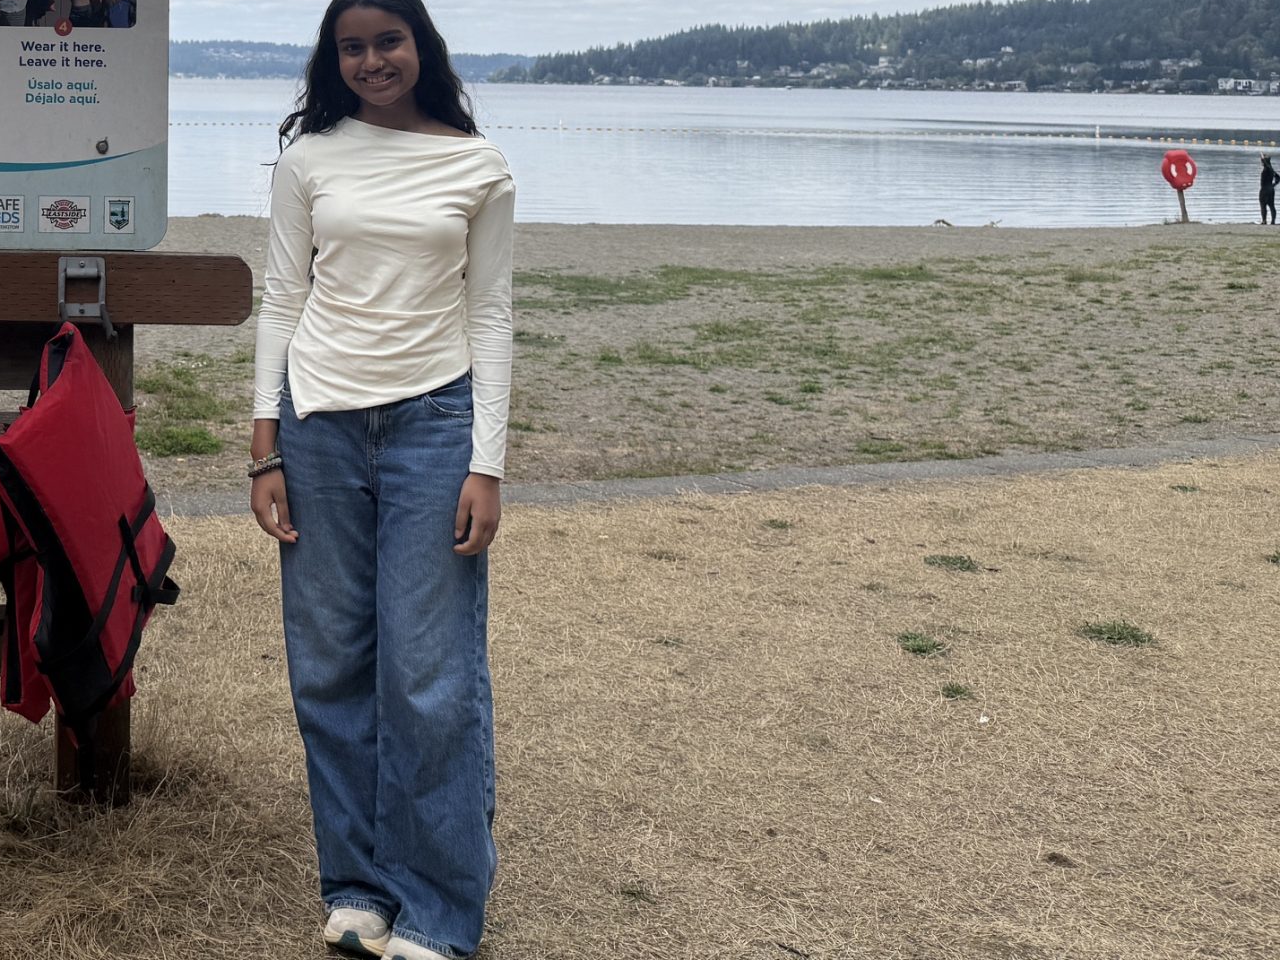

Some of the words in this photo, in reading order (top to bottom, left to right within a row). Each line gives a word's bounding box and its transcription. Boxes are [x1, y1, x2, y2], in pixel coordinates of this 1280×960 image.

[21, 41, 56, 51] Wear
[60, 42, 68, 52] it
[73, 42, 105, 52] here.
[20, 57, 57, 66] Leave
[62, 57, 70, 67] it
[75, 57, 106, 67] here.
[29, 78, 63, 93] Úsalo
[67, 80, 97, 92] aquí.
[26, 93, 65, 104] Déjalo
[70, 94, 100, 105] aquí.
